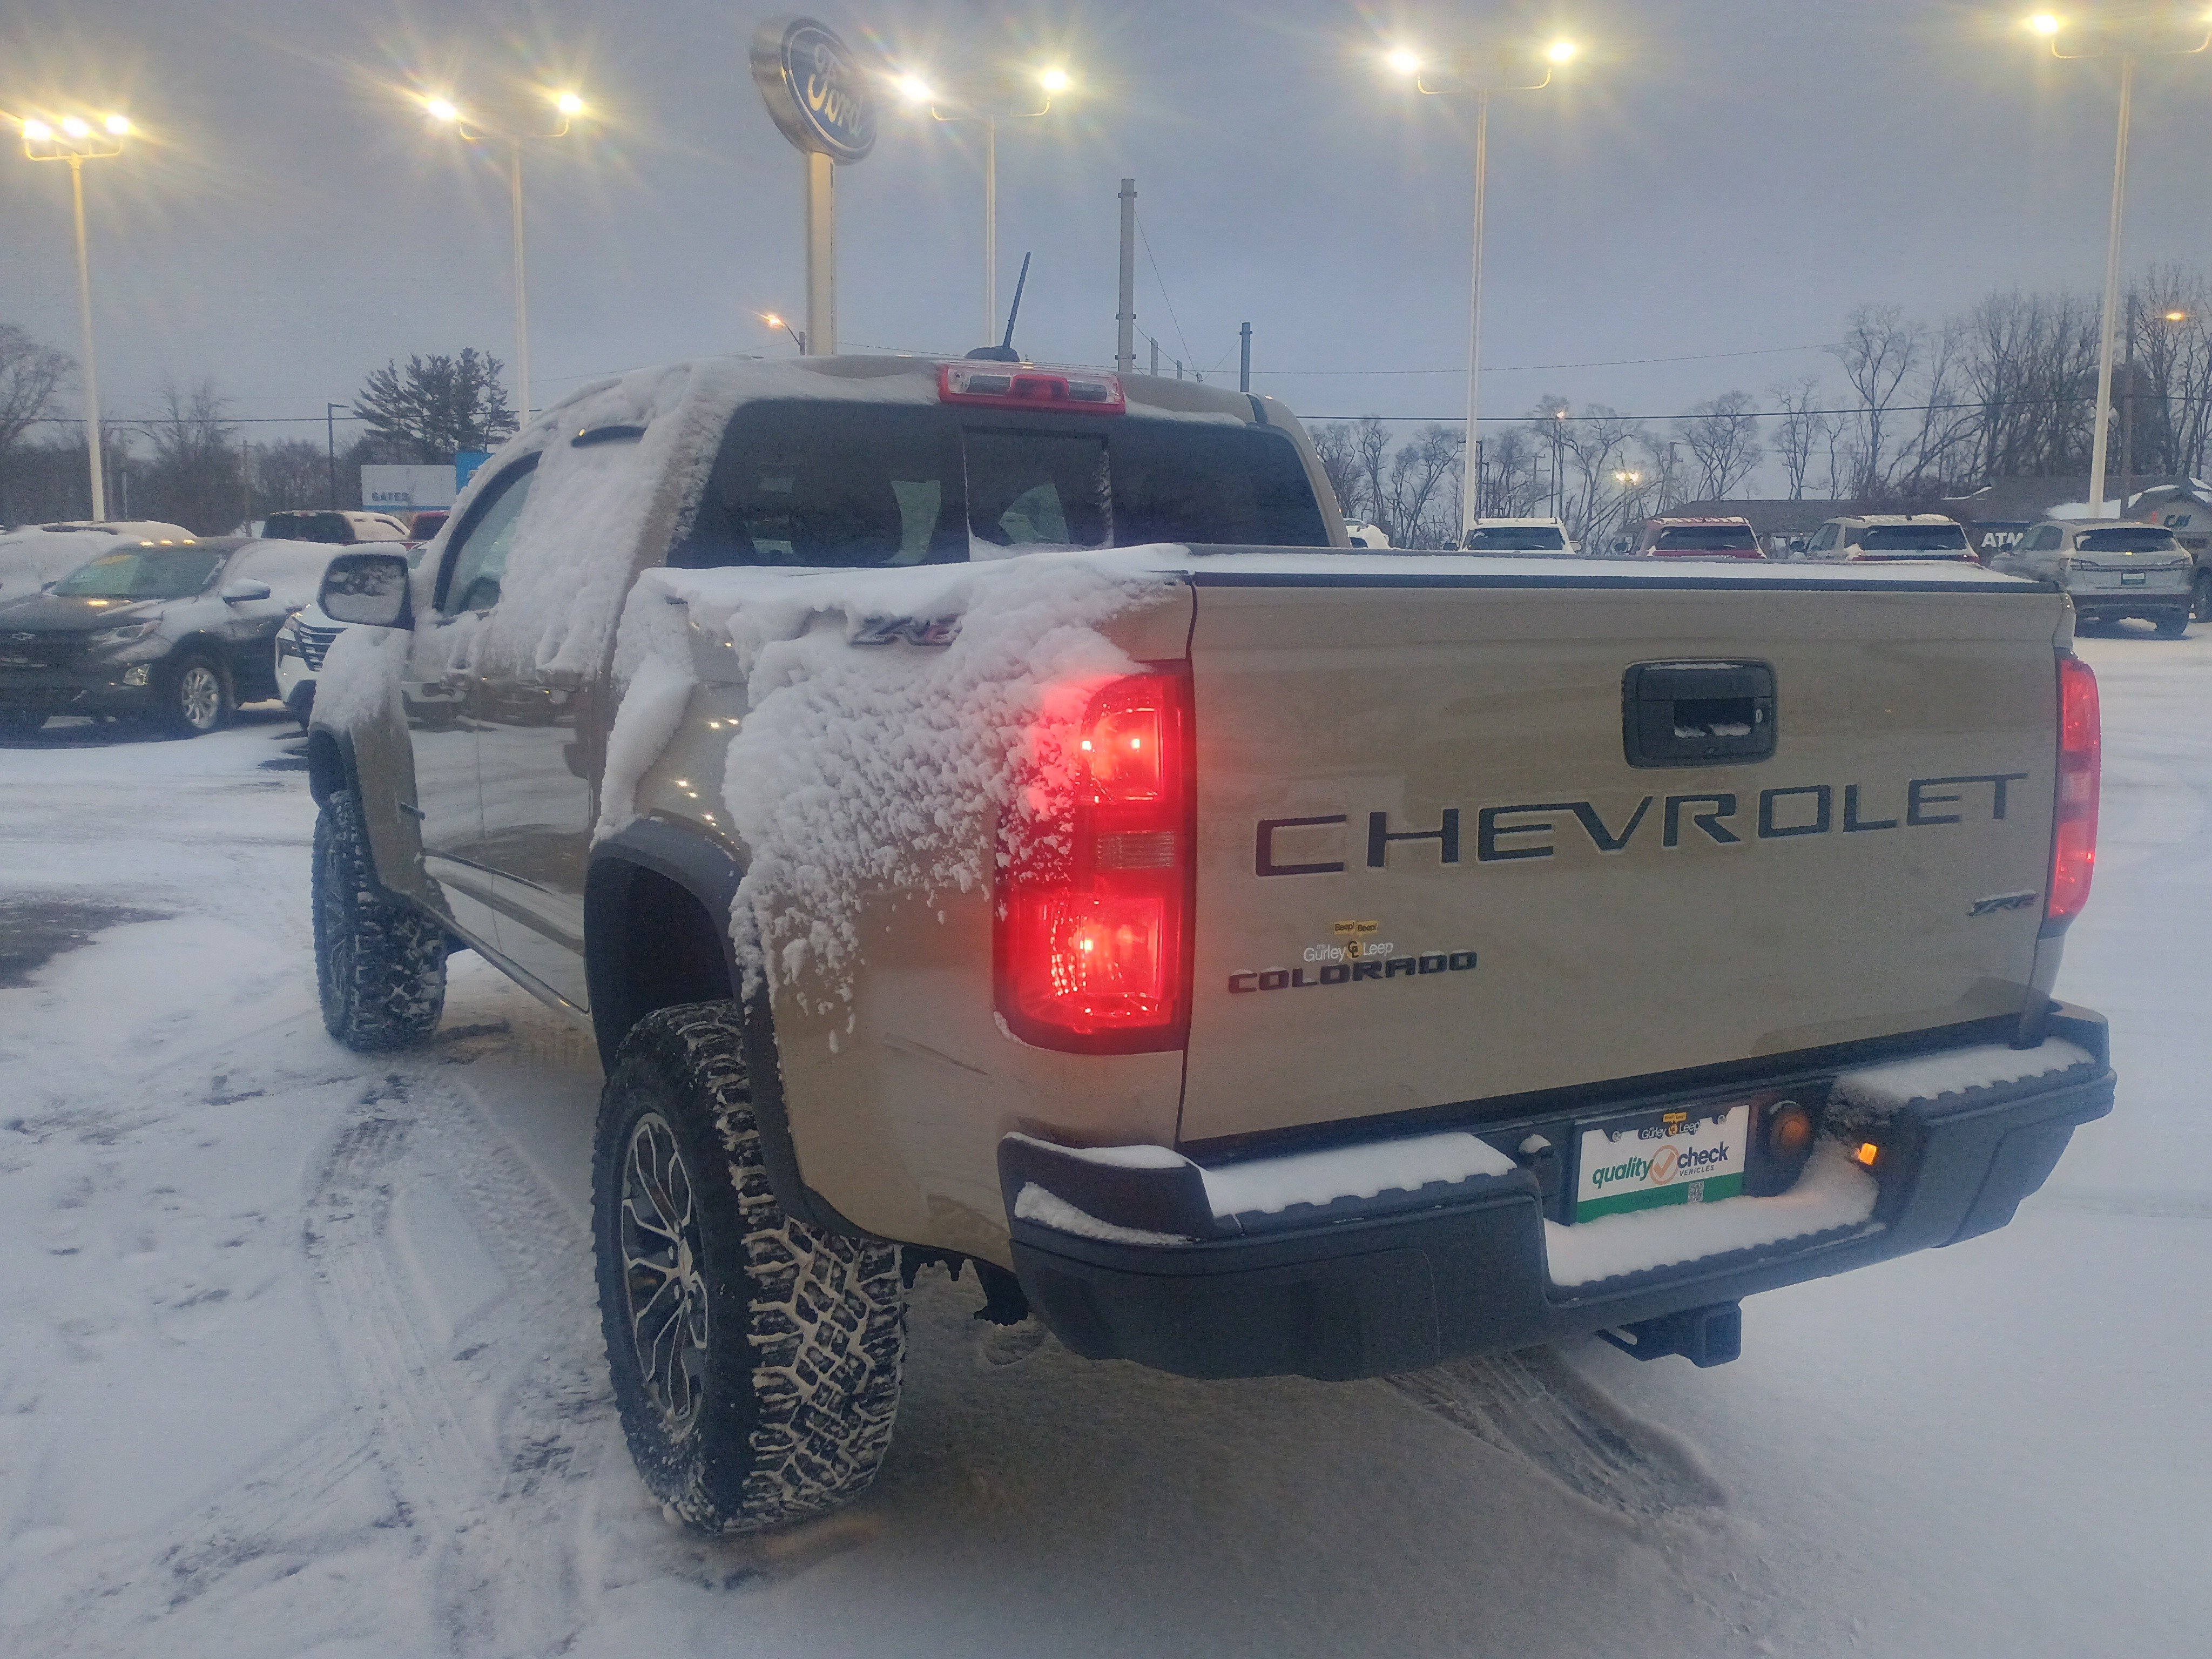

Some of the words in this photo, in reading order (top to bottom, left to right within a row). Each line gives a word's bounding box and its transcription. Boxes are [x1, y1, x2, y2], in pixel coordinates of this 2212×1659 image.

[807, 43, 865, 137] Ford
[1255, 772, 2029, 877] CHEVROLET
[1334, 922, 1355, 932] Beep!
[1357, 923, 1378, 932] Beep!
[1303, 944, 1346, 962] Gurley
[1363, 942, 1393, 956] Leep
[1228, 950, 1478, 994] COLORADO
[1680, 1122, 1701, 1134] Leep
[1592, 1157, 1655, 1189] quality
[1677, 1141, 1730, 1169] check
[1680, 1164, 1715, 1177] VEHICLES
